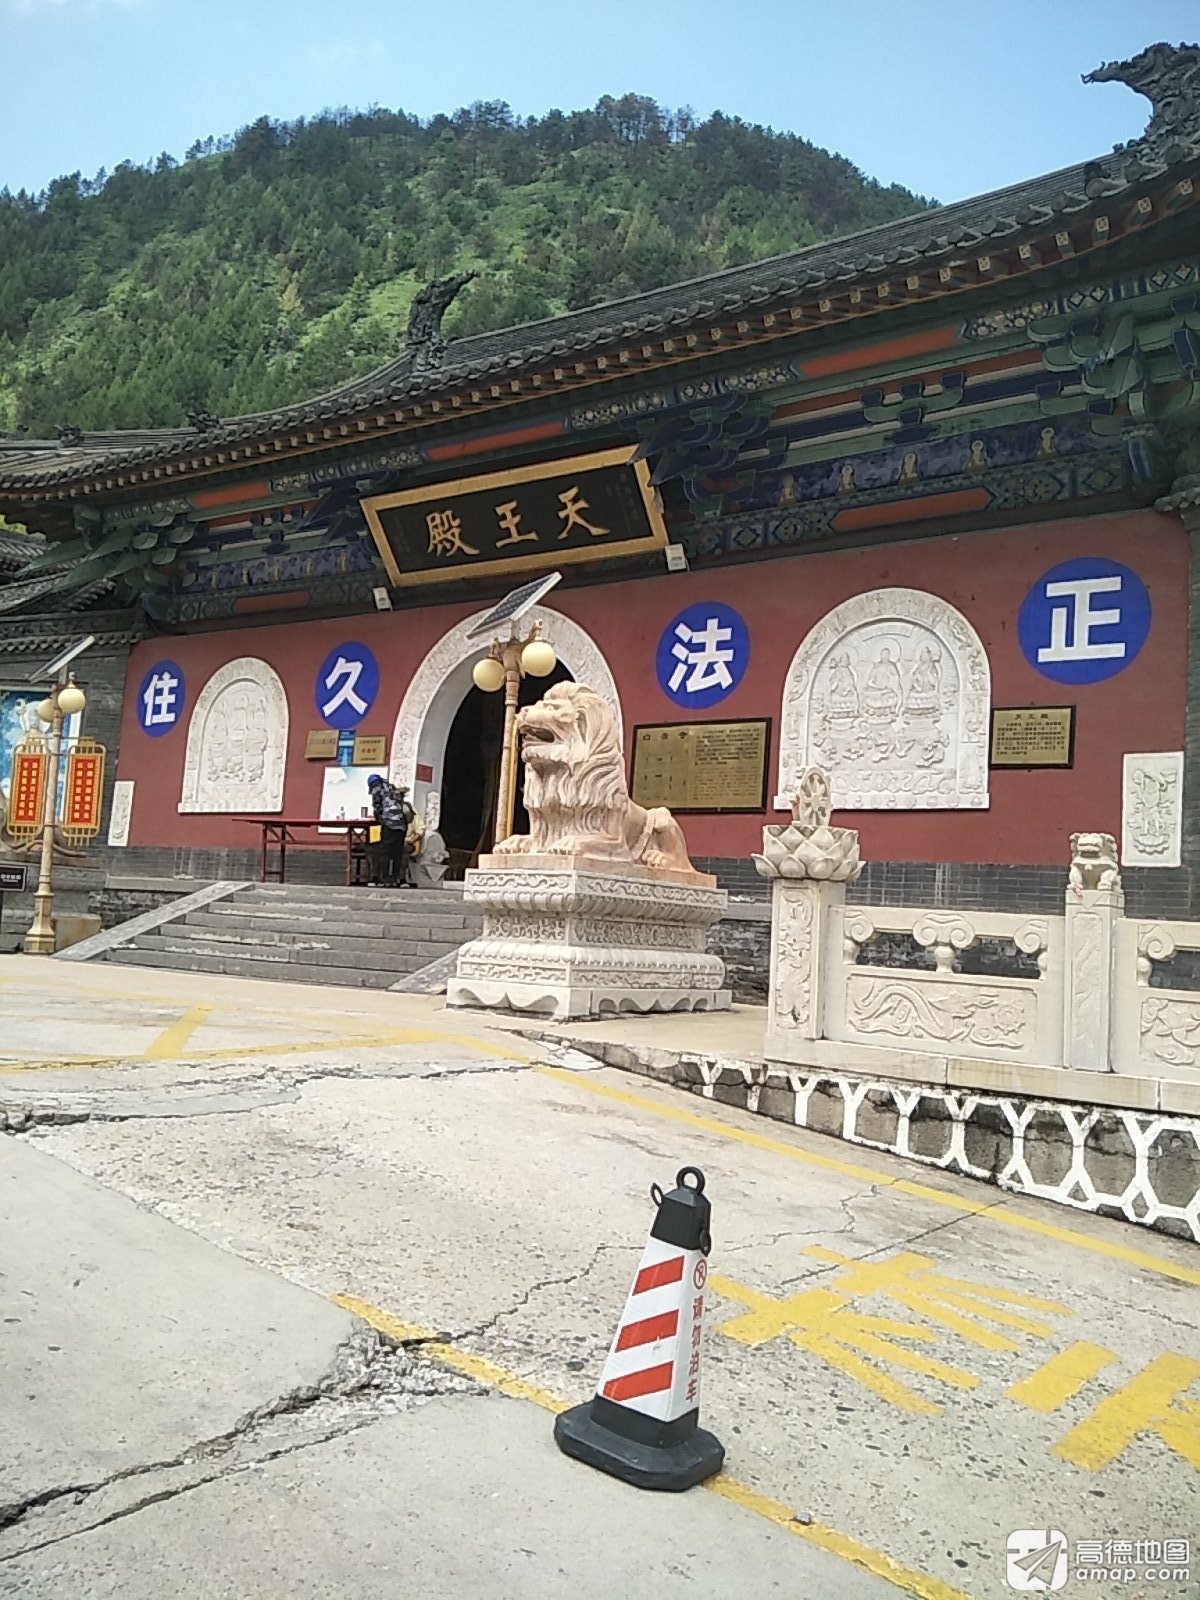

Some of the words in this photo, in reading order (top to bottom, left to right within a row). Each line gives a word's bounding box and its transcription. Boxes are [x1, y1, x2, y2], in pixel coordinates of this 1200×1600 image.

[426, 485, 610, 558] 天王殿
[667, 617, 735, 693] 法
[1036, 575, 1126, 663] 正
[143, 670, 177, 727] 住
[322, 656, 369, 718] 久
